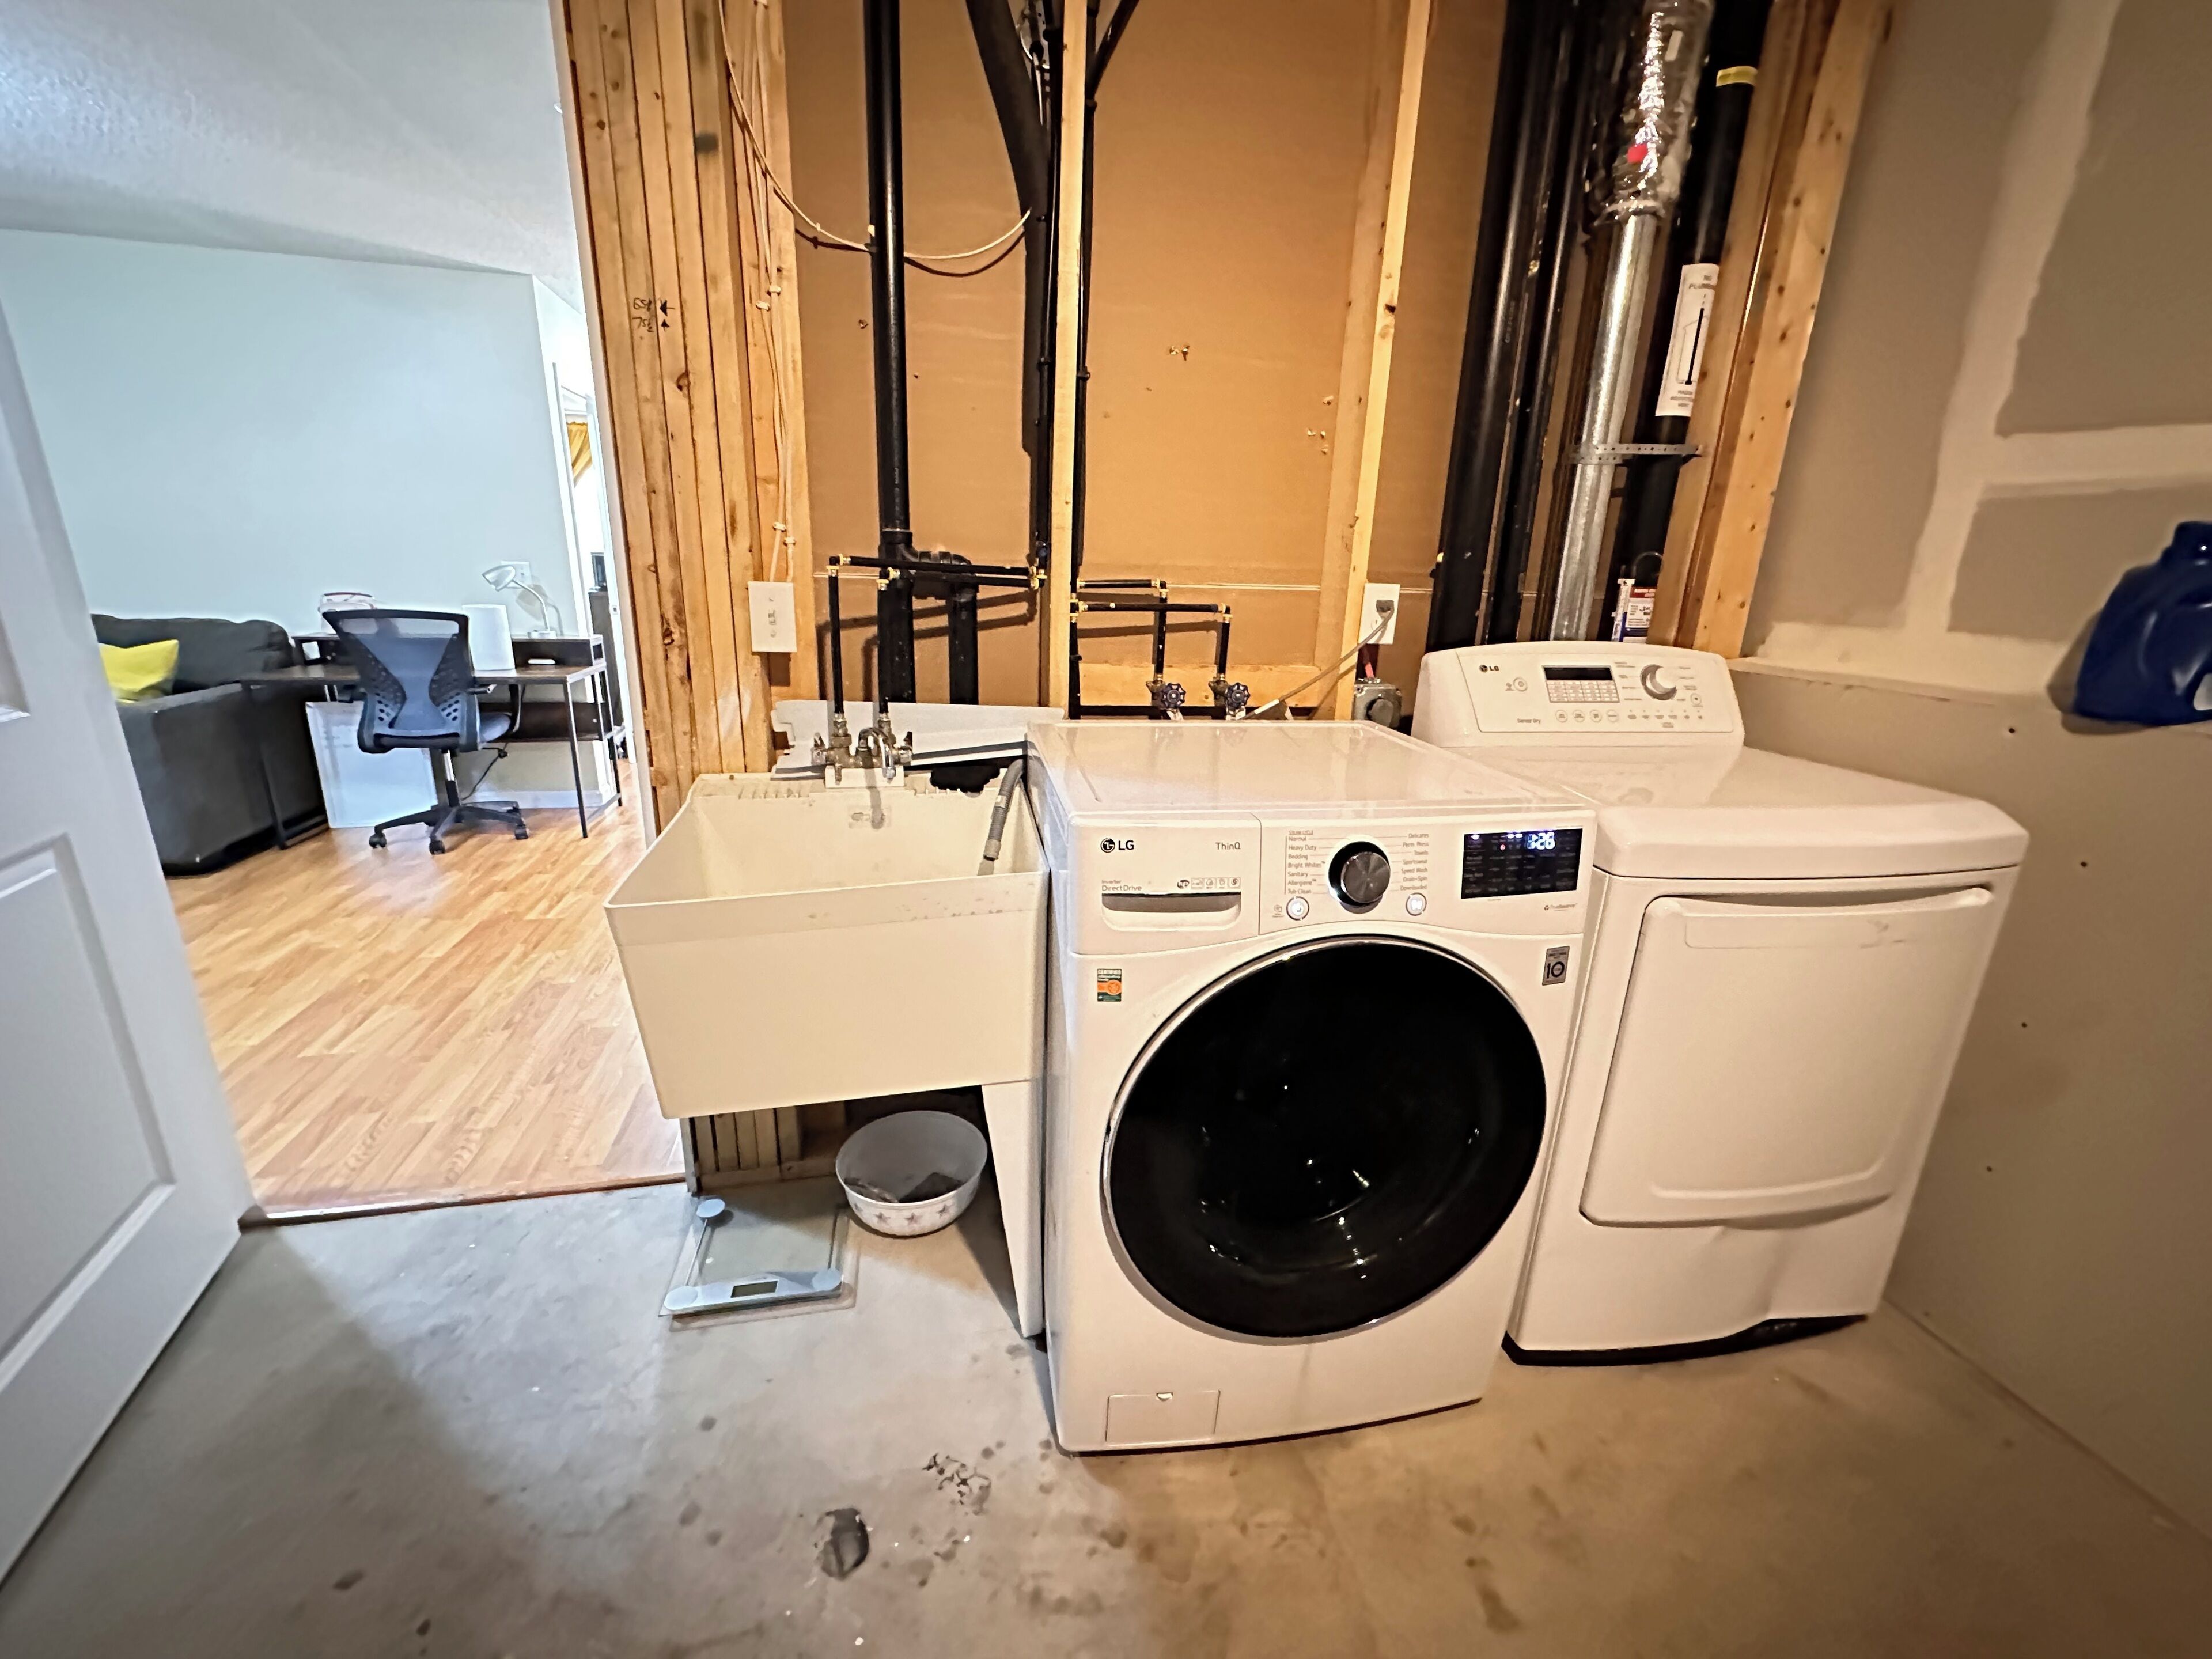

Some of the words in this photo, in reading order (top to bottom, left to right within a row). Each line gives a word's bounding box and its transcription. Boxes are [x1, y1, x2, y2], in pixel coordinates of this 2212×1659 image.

[1118, 840, 1134, 850] LG
[1215, 842, 1241, 850] ThinQ
[1547, 961, 1565, 979] 10
